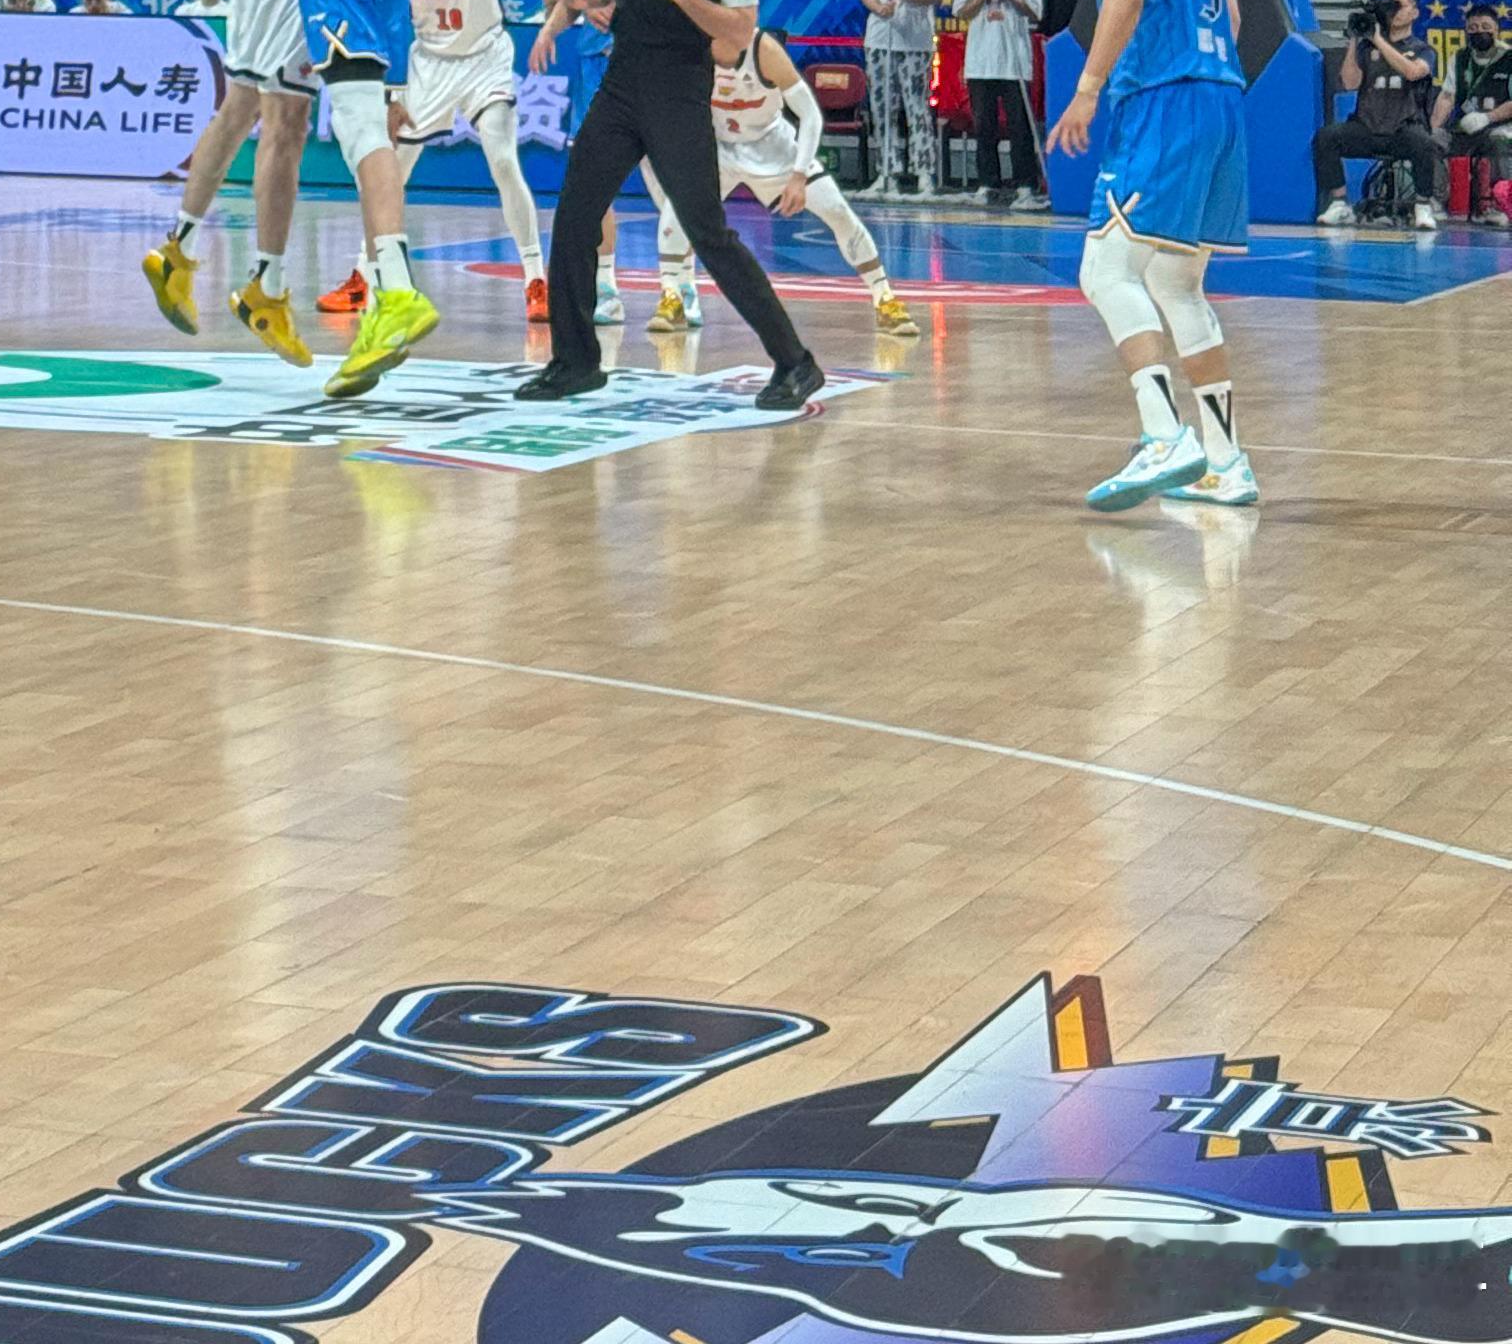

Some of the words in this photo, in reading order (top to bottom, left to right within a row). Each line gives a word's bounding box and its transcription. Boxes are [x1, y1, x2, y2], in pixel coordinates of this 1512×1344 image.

[2, 57, 201, 104] 中国人寿
[0, 107, 107, 132] CHINA
[120, 111, 195, 135] LIFE
